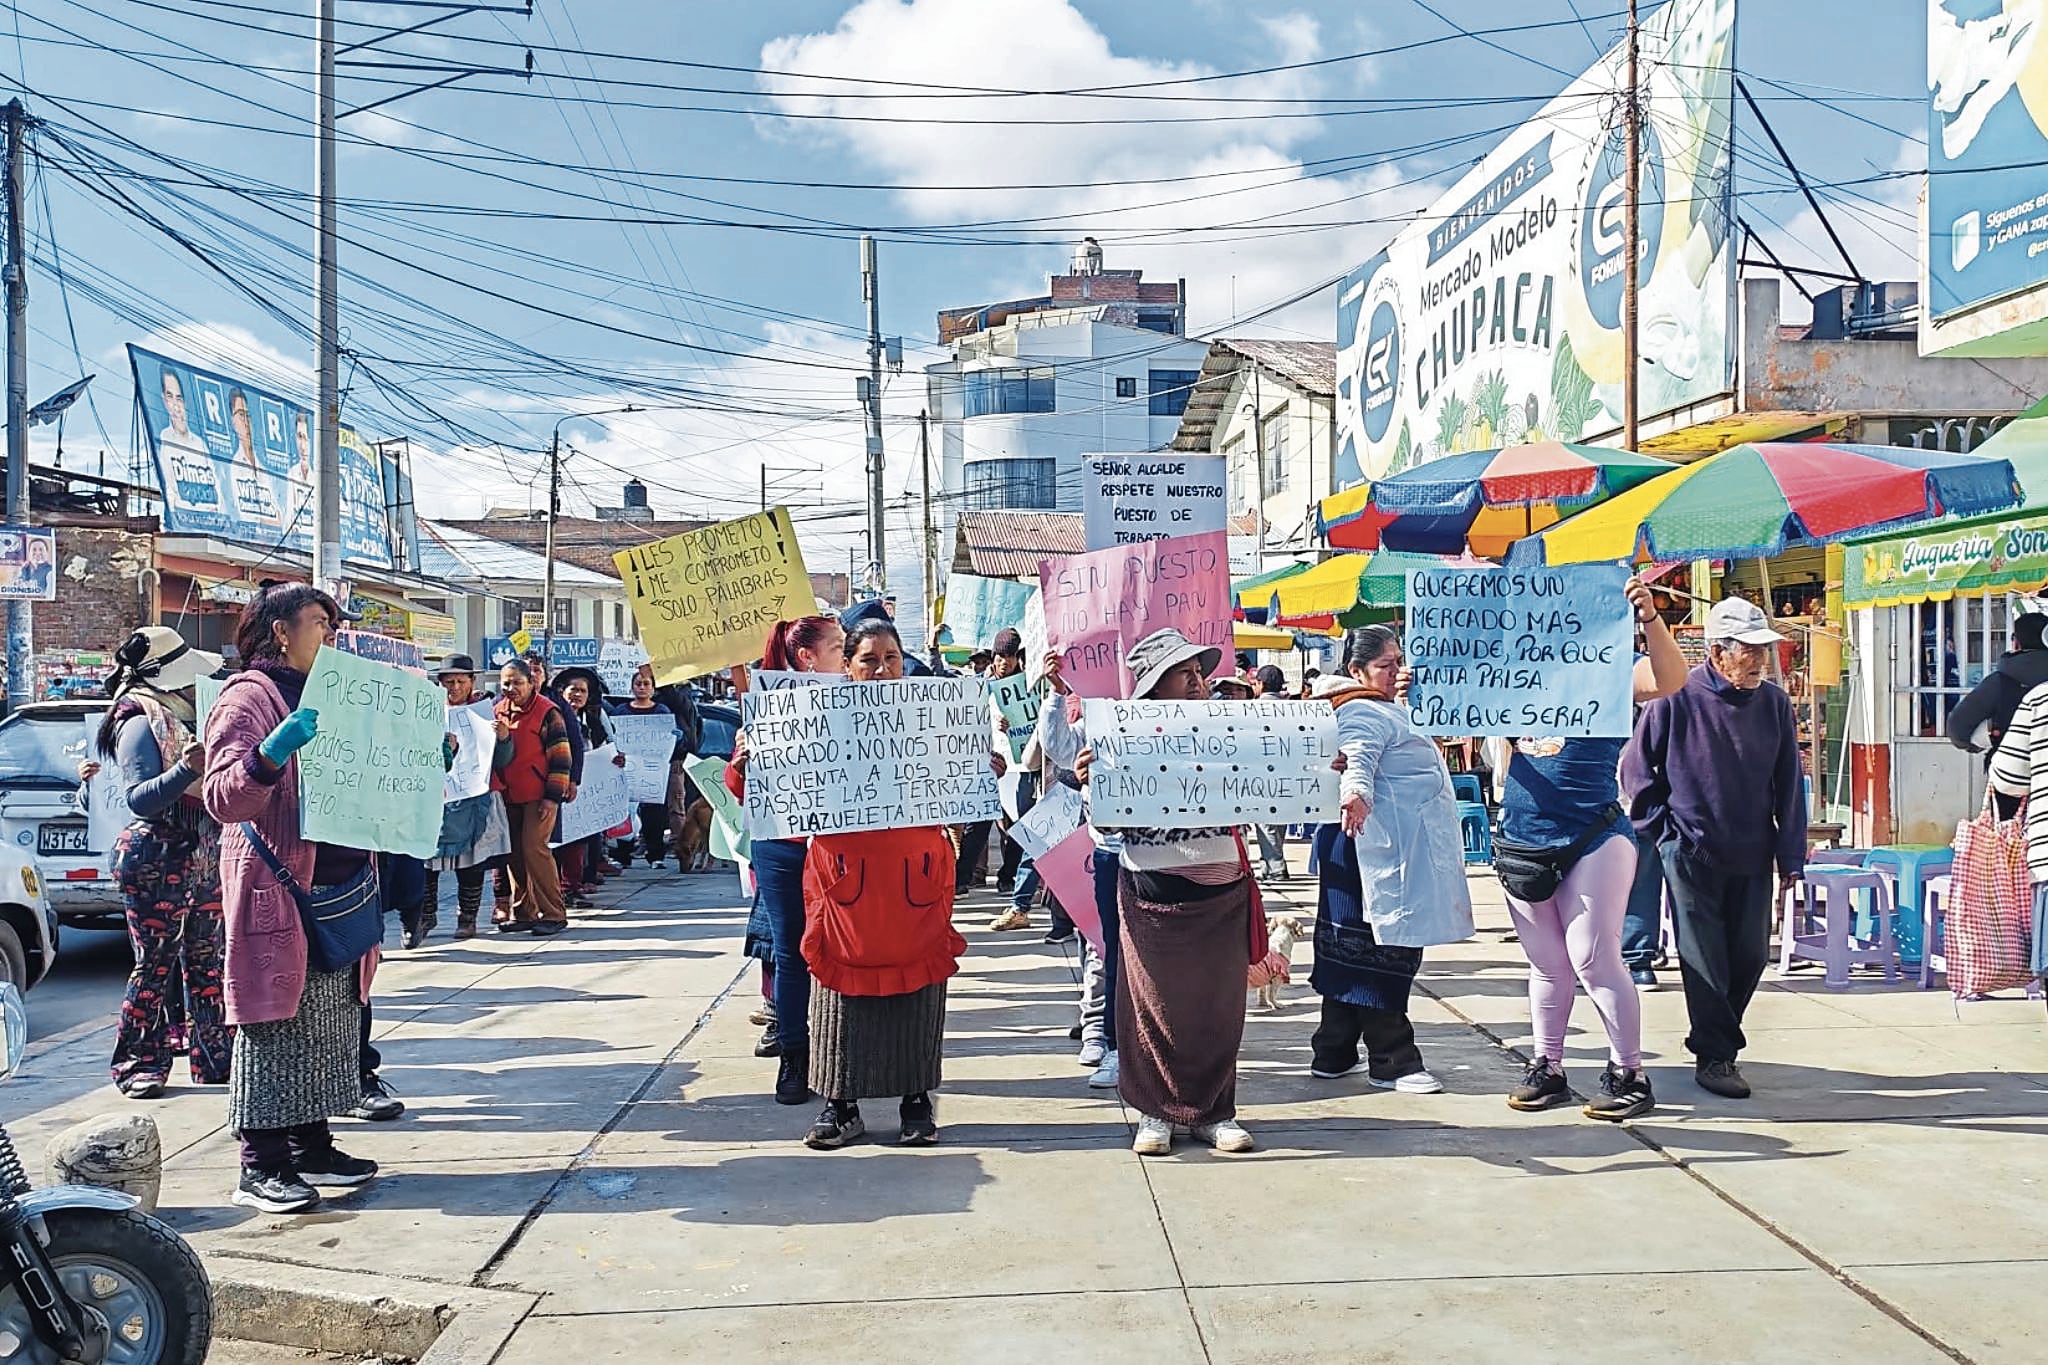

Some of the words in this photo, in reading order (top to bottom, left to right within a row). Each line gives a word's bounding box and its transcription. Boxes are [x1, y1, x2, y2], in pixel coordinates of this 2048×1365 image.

[1435, 156, 1536, 251] BIENVENIDOS
[1997, 220, 2029, 244] GANA
[1419, 246, 1483, 316] Mercado
[1489, 193, 1558, 270] Modelo
[1591, 238, 1649, 288] FORWD
[1415, 271, 1554, 413] CHUPACA
[1137, 463, 1186, 476] ALCALDE
[1101, 483, 1155, 497] RESPETE
[1167, 485, 1223, 498] NUESTRO
[1114, 507, 1157, 521] PUESTO
[1171, 509, 1192, 521] DE
[2006, 525, 2048, 558] Son
[705, 567, 788, 607] PALABRAS
[1057, 564, 1109, 598] SIN
[1413, 571, 1525, 598] QUEREMOS
[1531, 575, 1564, 598] UN
[1062, 610, 1088, 634] NO
[1105, 598, 1150, 625] HAY
[1165, 591, 1206, 616] PAN
[1411, 606, 1517, 631] MERCADO
[1515, 633, 1555, 662] POR
[1561, 640, 1615, 664] QUE
[1411, 664, 1468, 685] TANTA
[322, 670, 407, 717] PUESTOS
[743, 691, 797, 721] NUEVA
[810, 680, 964, 711] REESTRUCTURACION
[976, 680, 985, 699] Y
[743, 713, 832, 748] REFORMA
[851, 707, 905, 737] PARA
[917, 706, 936, 731] EL
[945, 703, 991, 729] NUEVO
[1114, 702, 1186, 723] BASTA
[1207, 702, 1233, 718] DE
[1243, 701, 1333, 718] MENTIRAS
[1466, 704, 1511, 728] QUE
[1521, 700, 1600, 736] SERA?
[858, 737, 885, 762] NO
[889, 736, 928, 762] NOS
[934, 733, 992, 755] TOMAN
[1091, 735, 1238, 761] MUESTRENOS
[1259, 735, 1291, 758] EN
[1302, 735, 1331, 759] EL
[748, 776, 769, 796] EN
[776, 767, 849, 792] CUENTA
[867, 764, 881, 782] A
[893, 763, 930, 781] LOS
[946, 760, 990, 779] DEL
[1092, 774, 1158, 802] PLANO
[1222, 776, 1321, 801] MAQUETA
[748, 788, 825, 819] PASAJE
[842, 782, 878, 804] LAS
